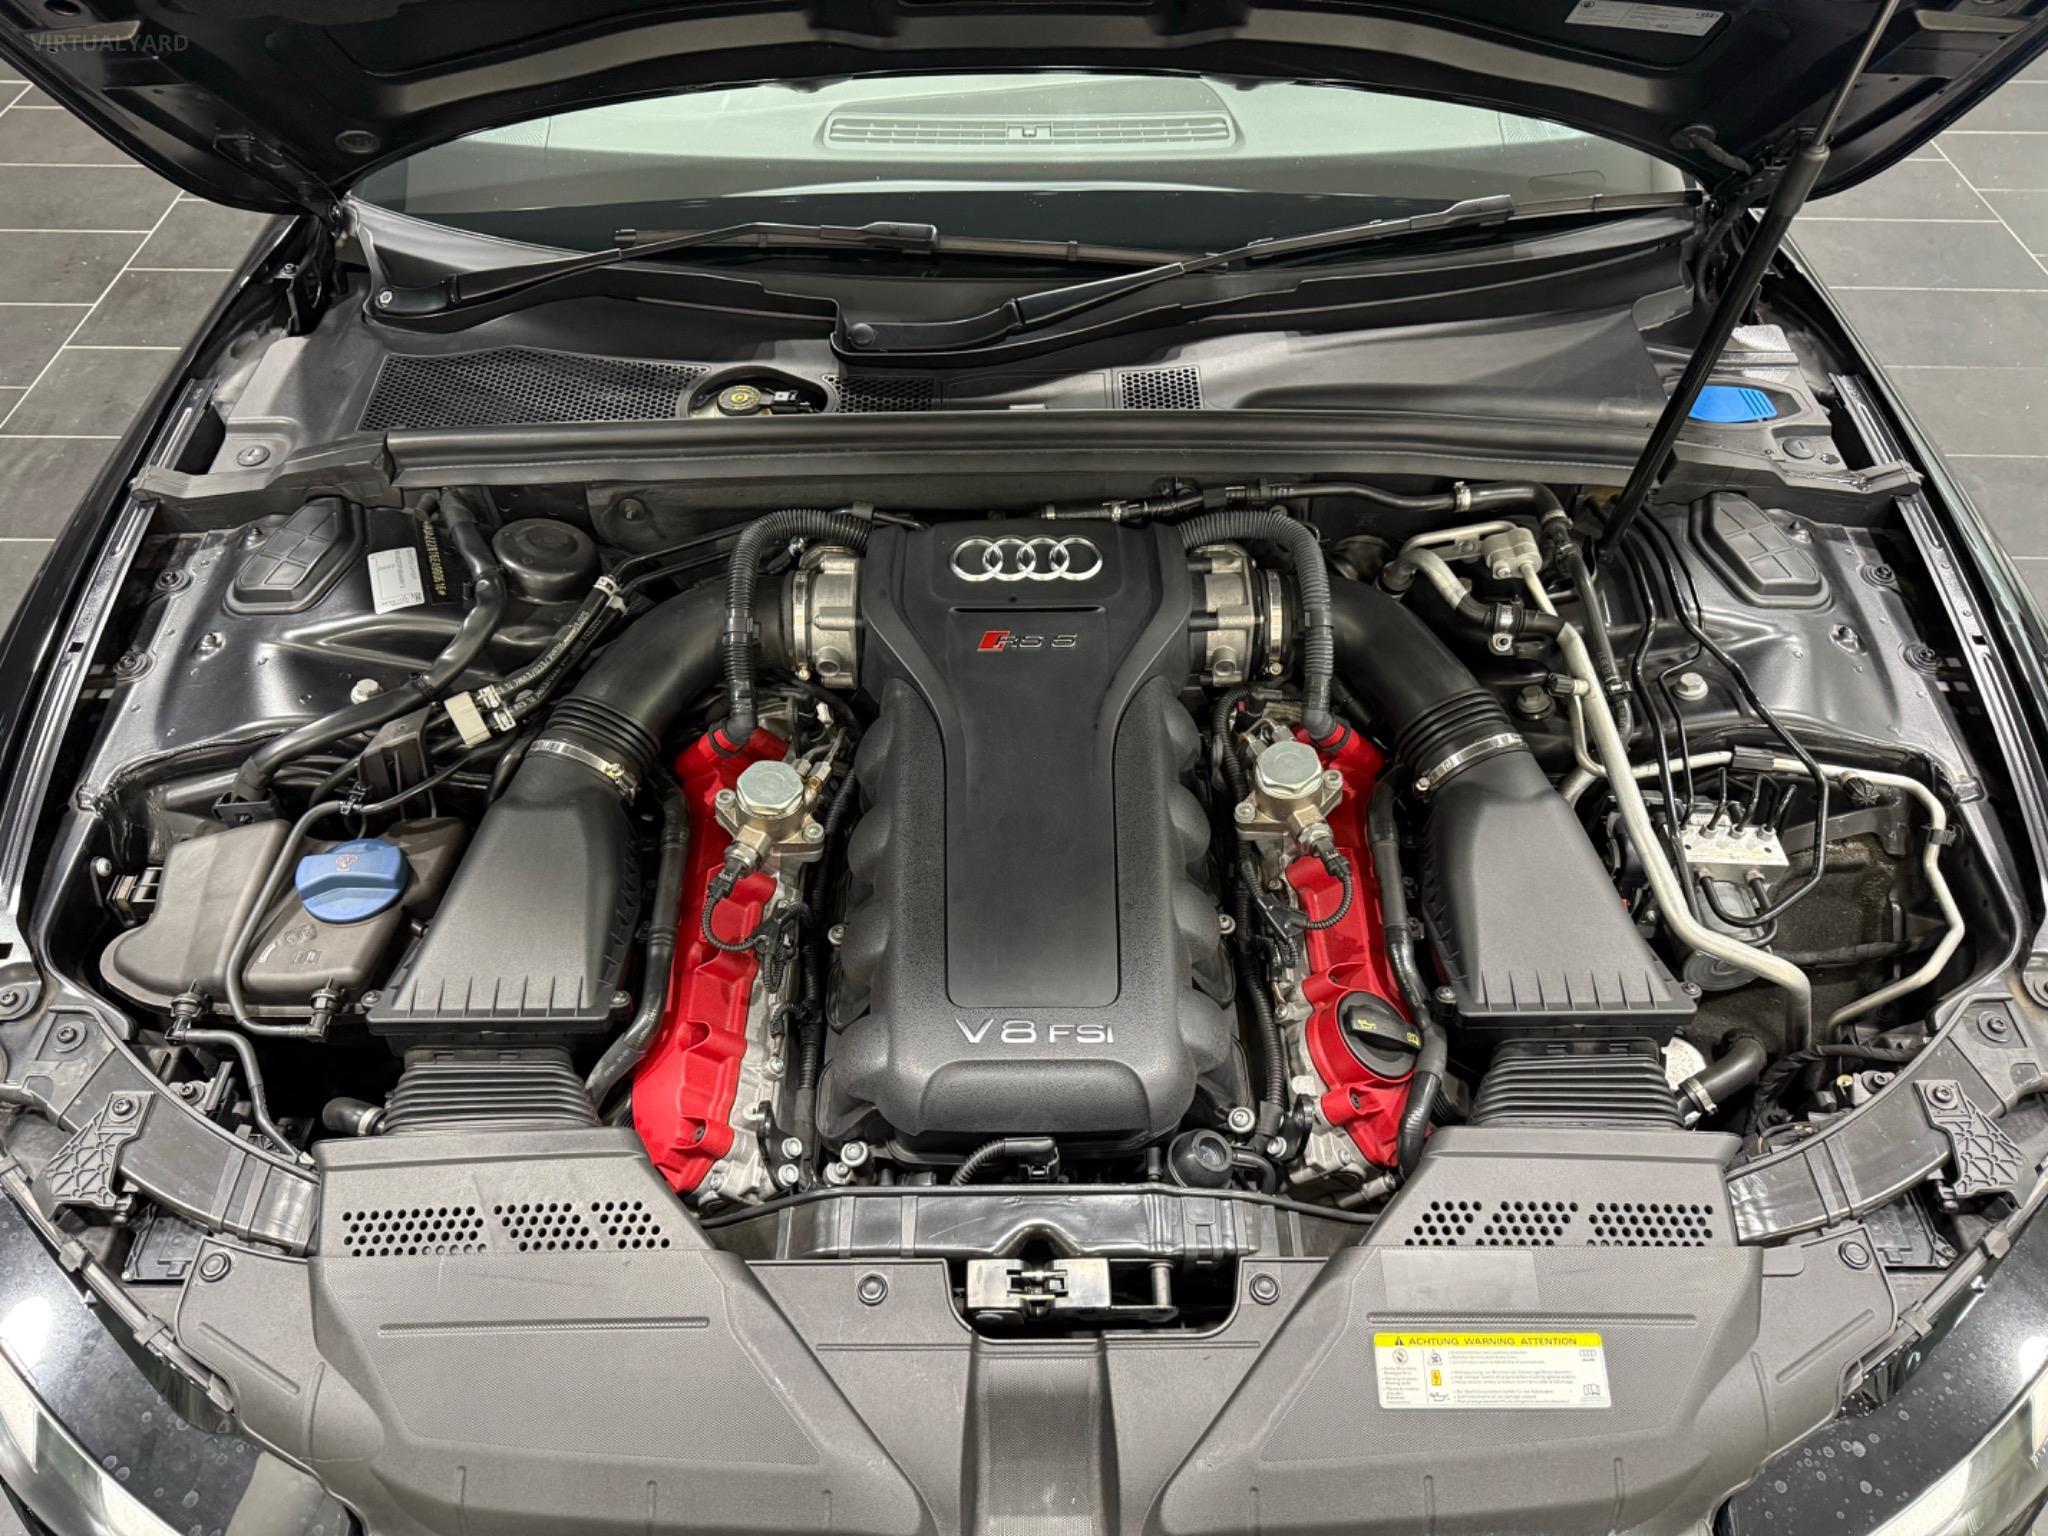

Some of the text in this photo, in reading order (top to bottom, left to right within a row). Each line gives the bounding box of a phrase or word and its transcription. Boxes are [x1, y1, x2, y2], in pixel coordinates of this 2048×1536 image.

[955, 1018, 1114, 1044] V8 FSI
[1409, 1336, 1577, 1346] ACHTUNG WARNING ATTENTION
